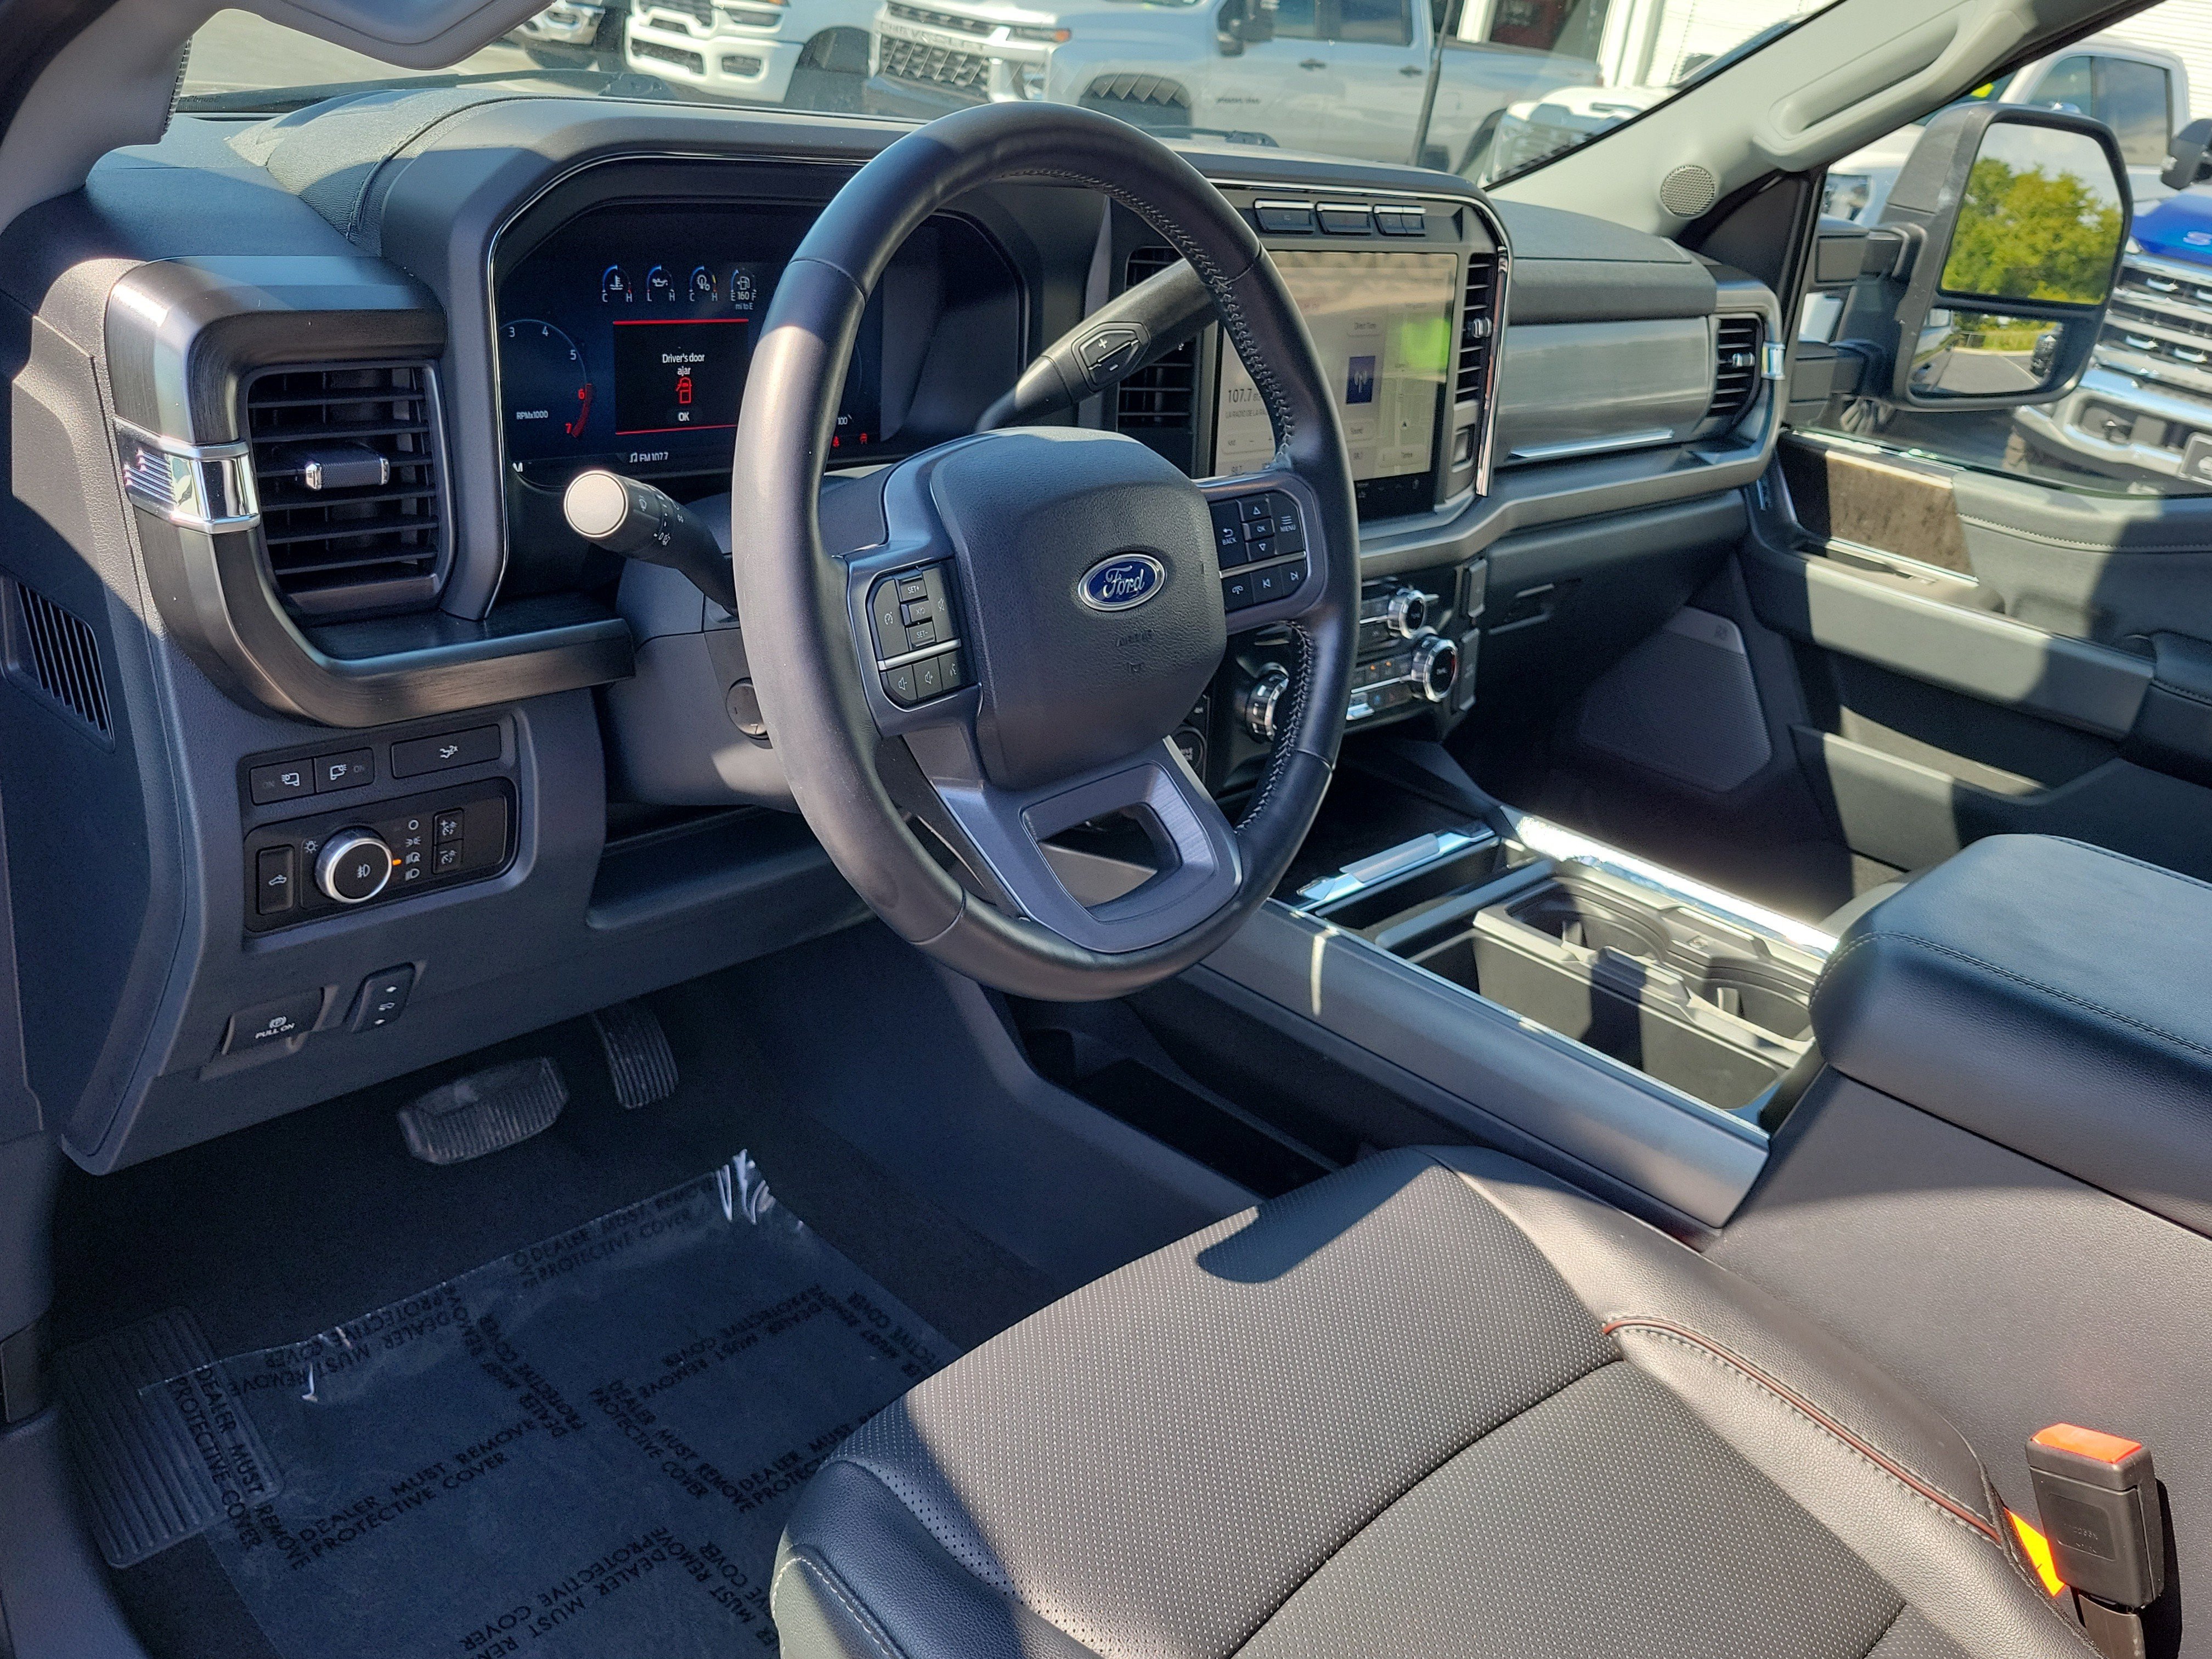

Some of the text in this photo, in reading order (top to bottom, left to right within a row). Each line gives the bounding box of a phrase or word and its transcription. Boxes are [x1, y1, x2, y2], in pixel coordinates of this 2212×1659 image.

[602, 293, 608, 302] C
[626, 293, 633, 302] H
[669, 292, 675, 301] H
[690, 292, 695, 301] C
[712, 292, 718, 301] H
[737, 292, 749, 300] 160
[509, 327, 515, 337] 3
[542, 326, 549, 336] 4
[570, 349, 576, 360] 5
[662, 352, 705, 363] Driver's door
[677, 366, 691, 376] ajar
[578, 388, 585, 399] 6
[1228, 388, 1252, 403] 107.7
[678, 412, 690, 421] OK
[837, 416, 848, 425] 100
[565, 422, 572, 433] 7
[1102, 565, 1146, 599] Ford
[255, 1022, 296, 1039] PULL ON
[299, 1418, 536, 1542] DEALER MUST REMOVE
[311, 1451, 511, 1558] PROTECTIVE COVER
[593, 1548, 667, 1596] DEALER
[459, 1534, 655, 1651] PROTECTIVE COVER
[528, 1596, 586, 1639] MUST
